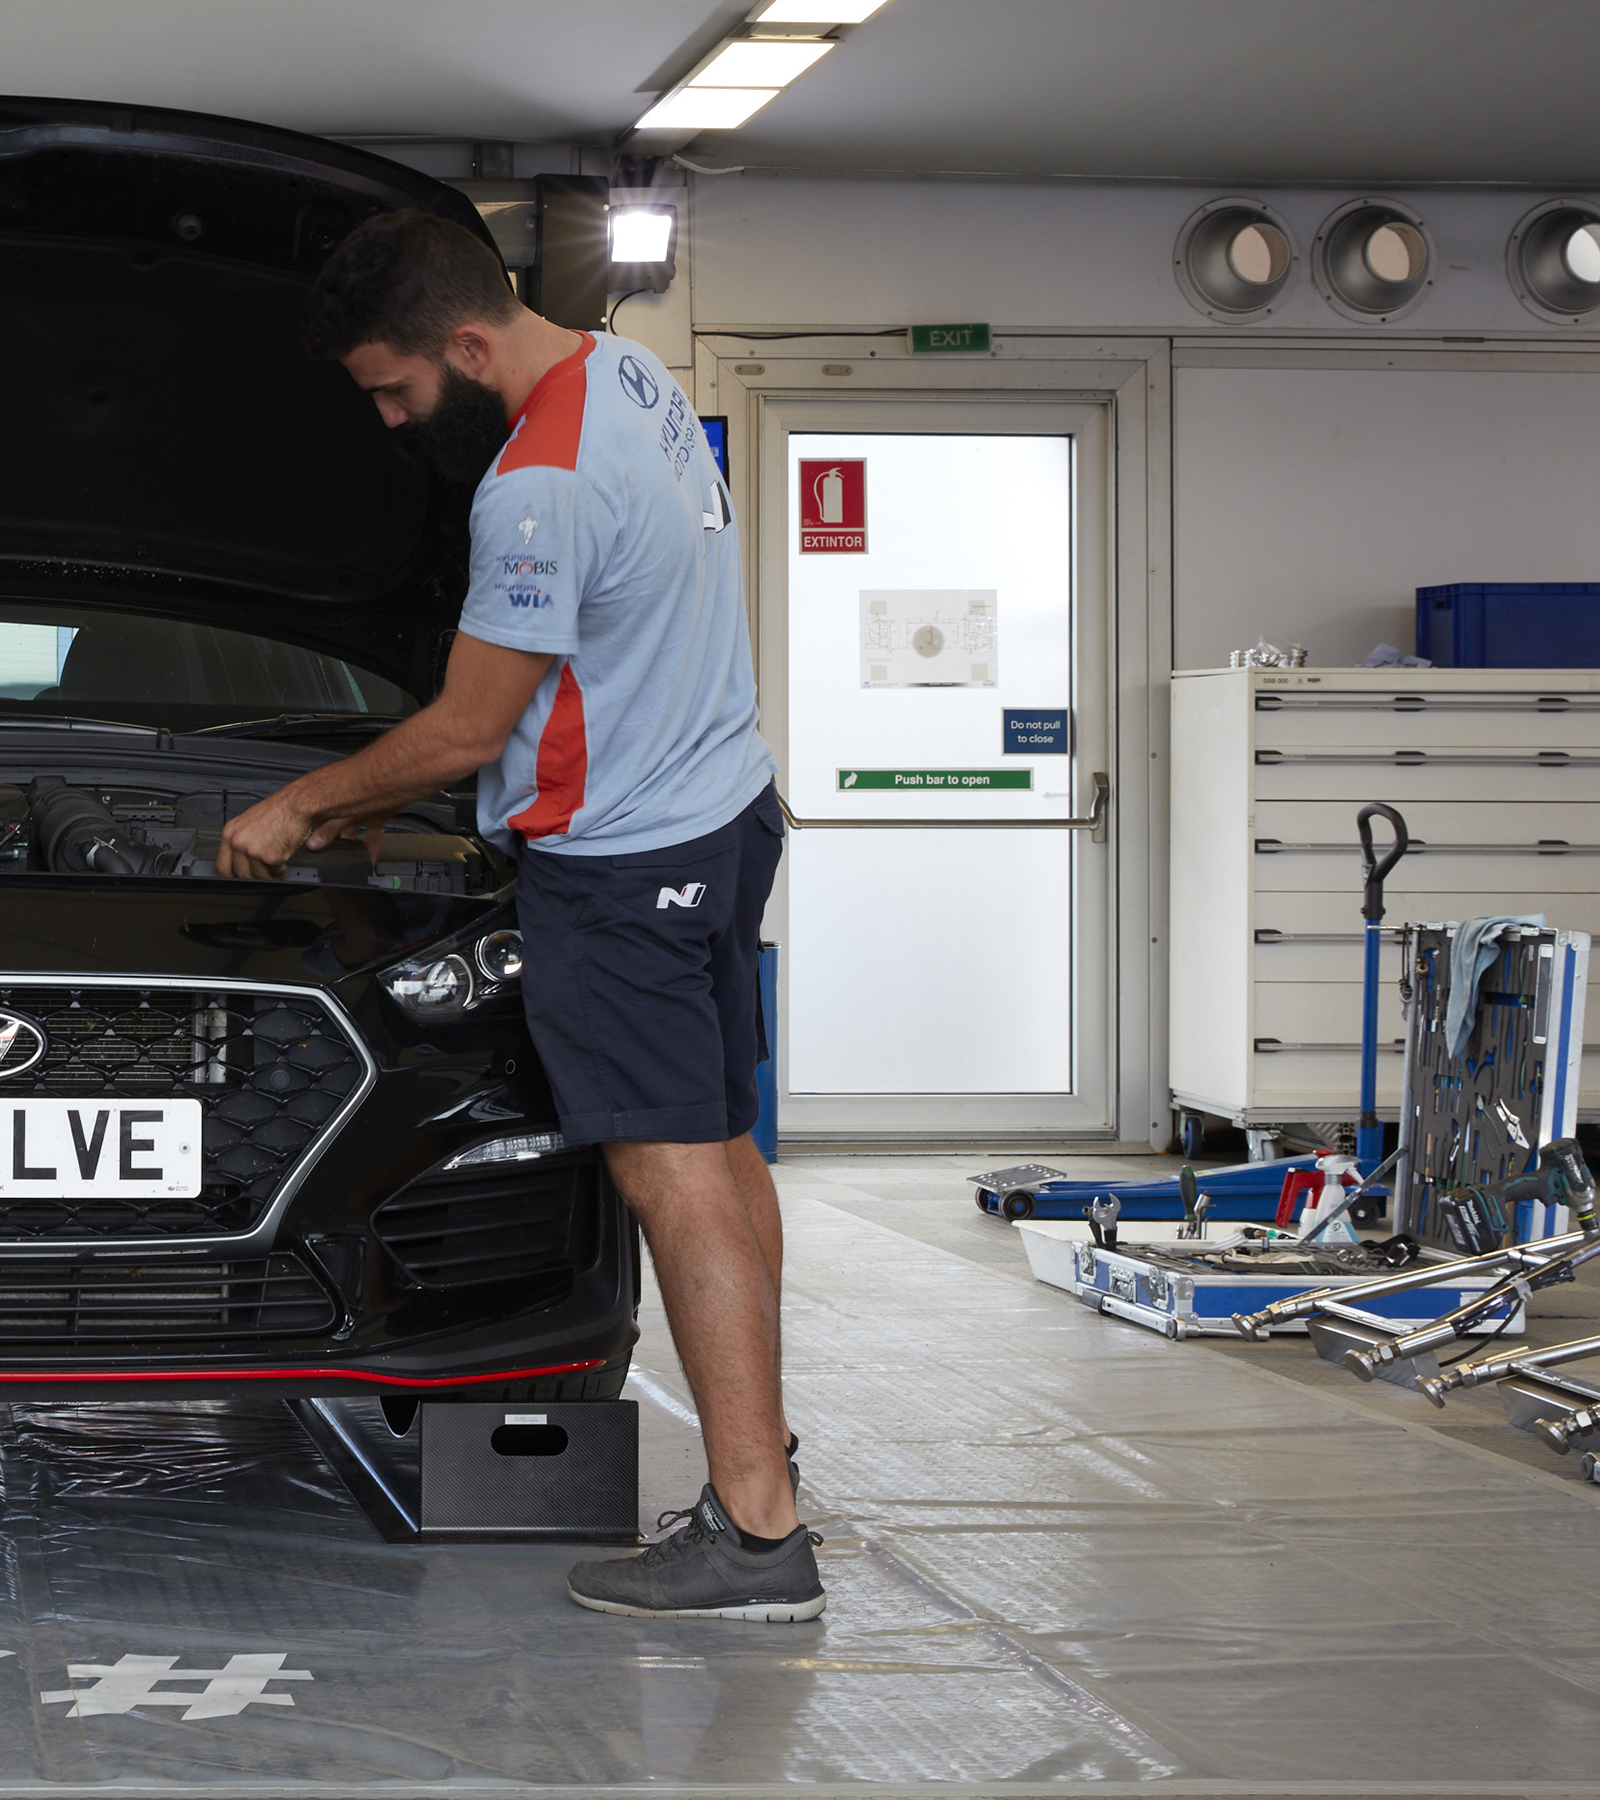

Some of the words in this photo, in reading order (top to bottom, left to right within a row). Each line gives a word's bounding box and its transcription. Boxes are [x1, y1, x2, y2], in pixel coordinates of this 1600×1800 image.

[929, 330, 973, 346] EXIT
[804, 536, 863, 548] EXTINTOR
[503, 560, 558, 577] MOBIS
[1010, 720, 1024, 730] Do
[1026, 721, 1042, 730] not
[1043, 720, 1061, 731] pull
[1017, 734, 1028, 744] to
[1029, 734, 1054, 744] close
[895, 774, 924, 785] Push
[926, 774, 946, 785] bar
[947, 775, 959, 785] to
[961, 776, 990, 787] open
[13, 1108, 164, 1181] LVE
